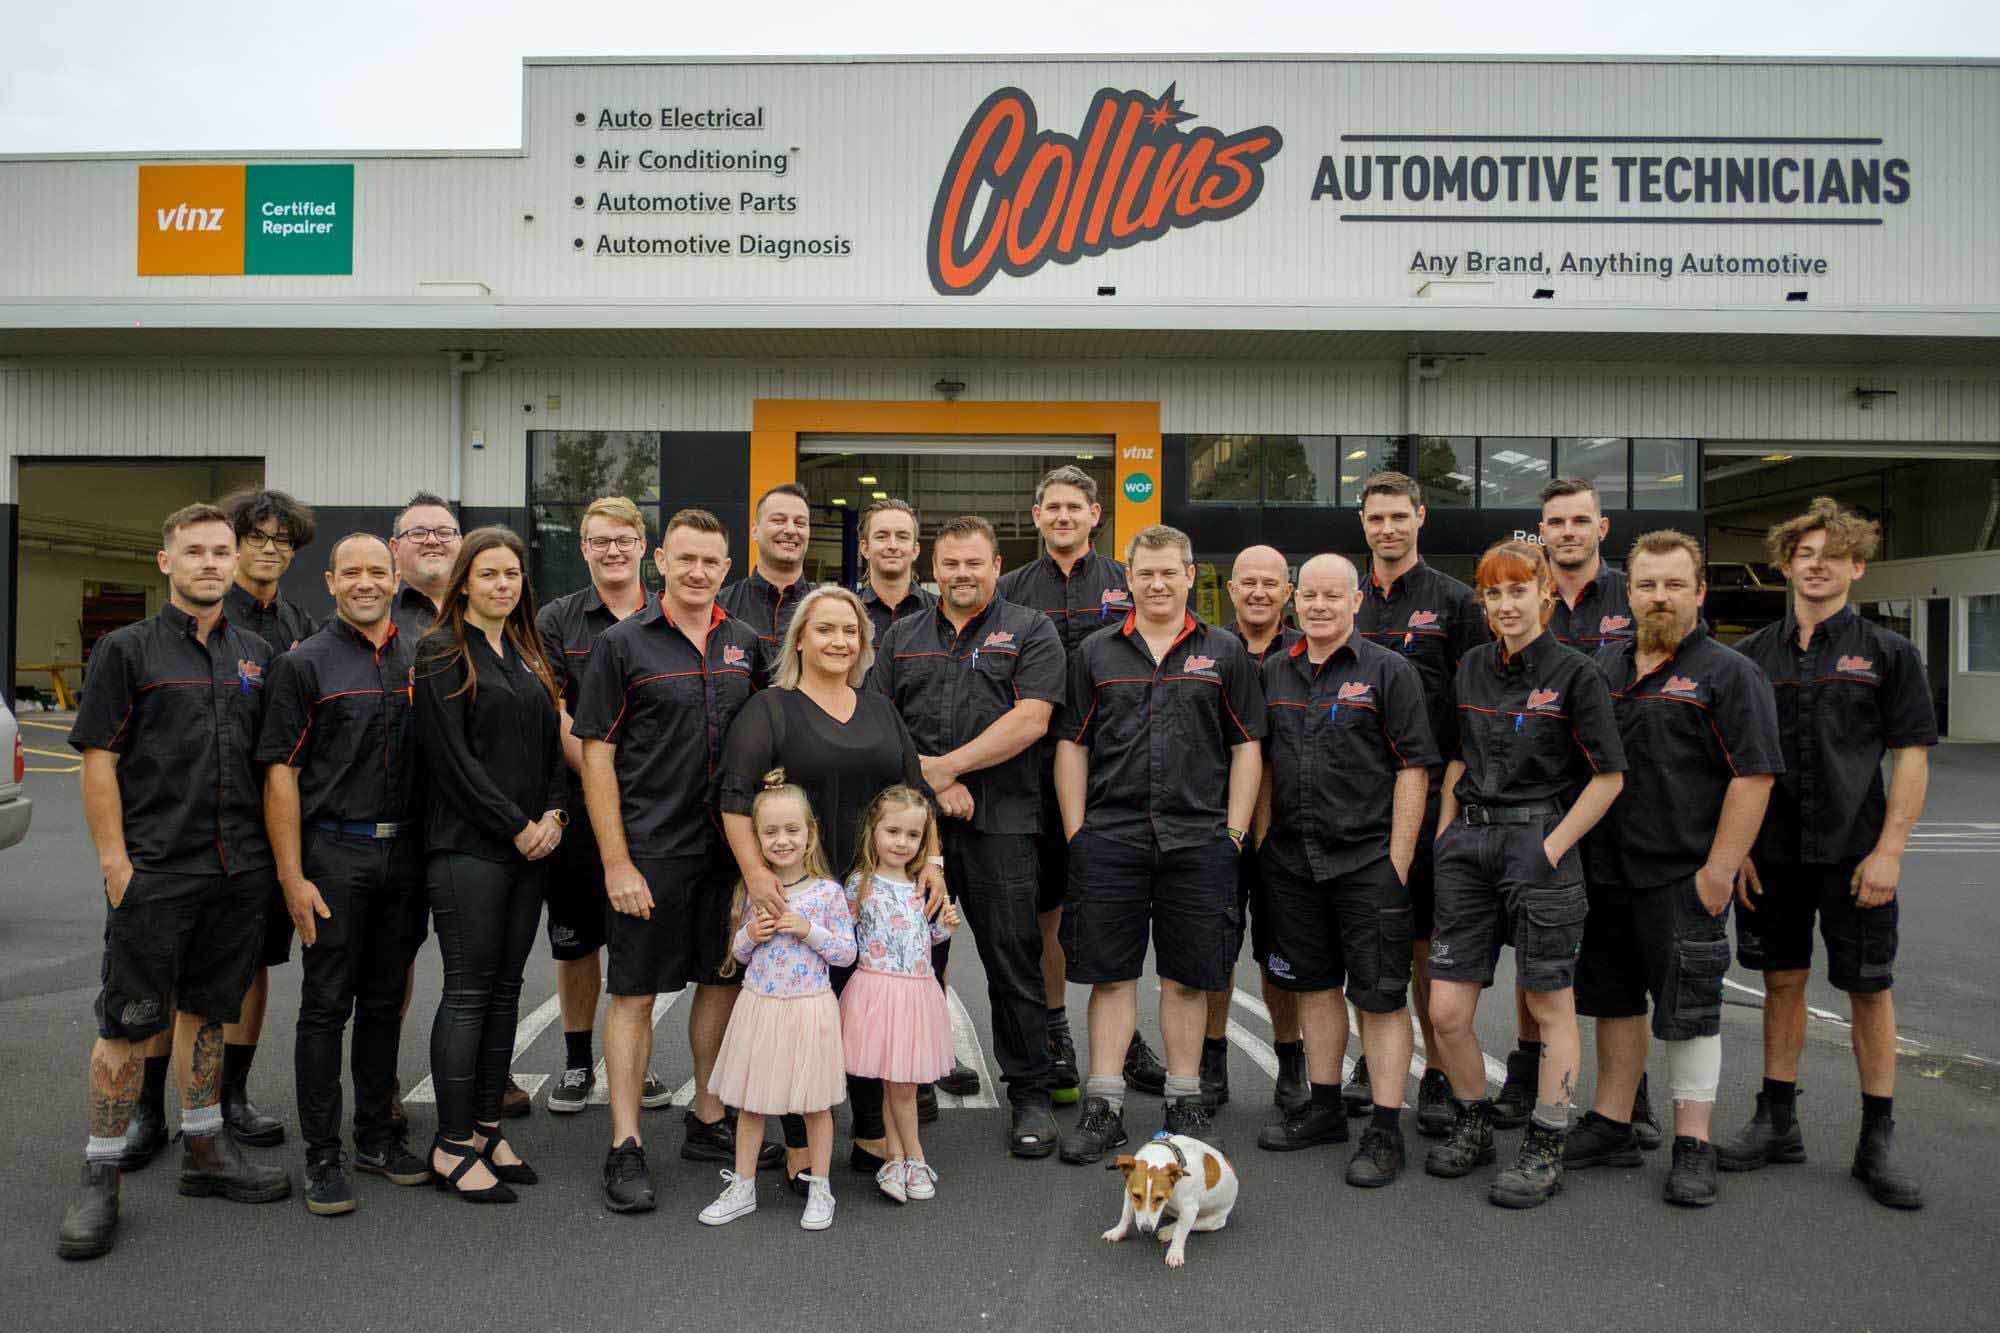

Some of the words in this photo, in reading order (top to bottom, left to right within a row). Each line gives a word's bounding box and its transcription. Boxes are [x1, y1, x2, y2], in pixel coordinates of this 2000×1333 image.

[598, 108, 652, 128] Auto
[661, 107, 764, 128] Electrical
[597, 149, 630, 170] Air
[638, 149, 788, 174] Conditioning
[1310, 154, 1598, 202] AUTOMOTIVE
[1612, 156, 1911, 204] TECHNICIANS
[928, 87, 1281, 294] Collins
[261, 201, 336, 216] Certified
[596, 192, 732, 212] Automotive
[740, 192, 797, 212] Parts
[157, 203, 225, 231] vtnz
[262, 220, 334, 237] Repairer
[596, 234, 732, 254] Automotive
[740, 234, 851, 258] Diagnosis
[1410, 251, 1458, 276] Any
[1466, 252, 1552, 274] Brand,
[1560, 252, 1674, 276] Anything
[1681, 253, 1829, 275] Automotive
[1122, 446, 1154, 460] vtnz
[1125, 482, 1152, 493] WOF
